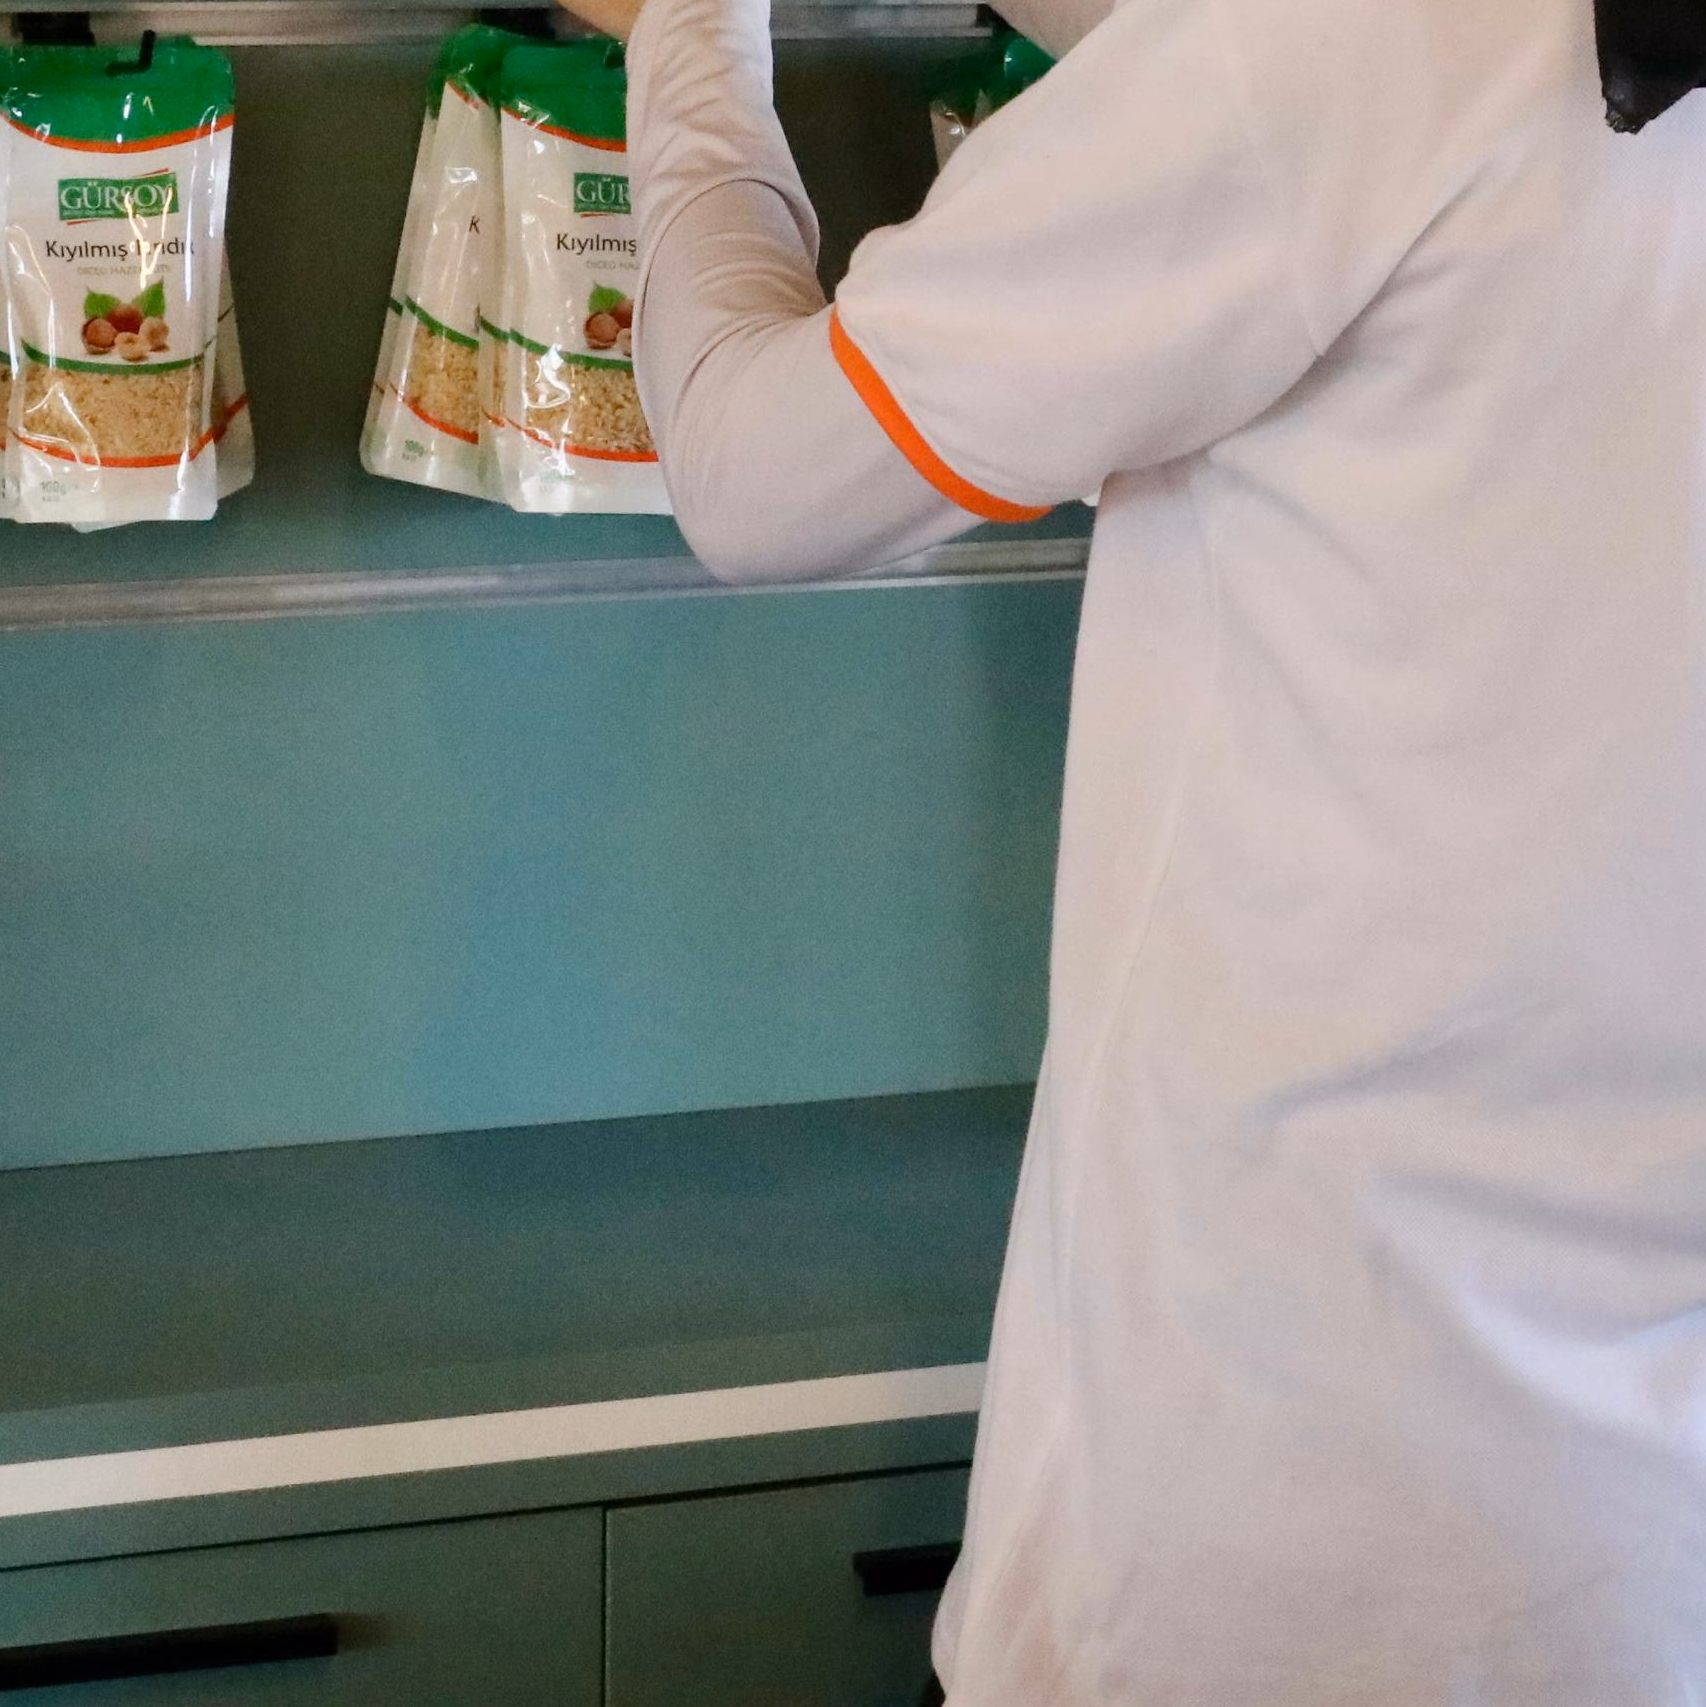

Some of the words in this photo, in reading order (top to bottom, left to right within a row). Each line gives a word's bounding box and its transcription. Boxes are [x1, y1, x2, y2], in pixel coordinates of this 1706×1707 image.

[576, 177, 630, 204] GÜR
[46, 240, 128, 262] Kıyılmış
[556, 233, 637, 256] Kıyılmış
